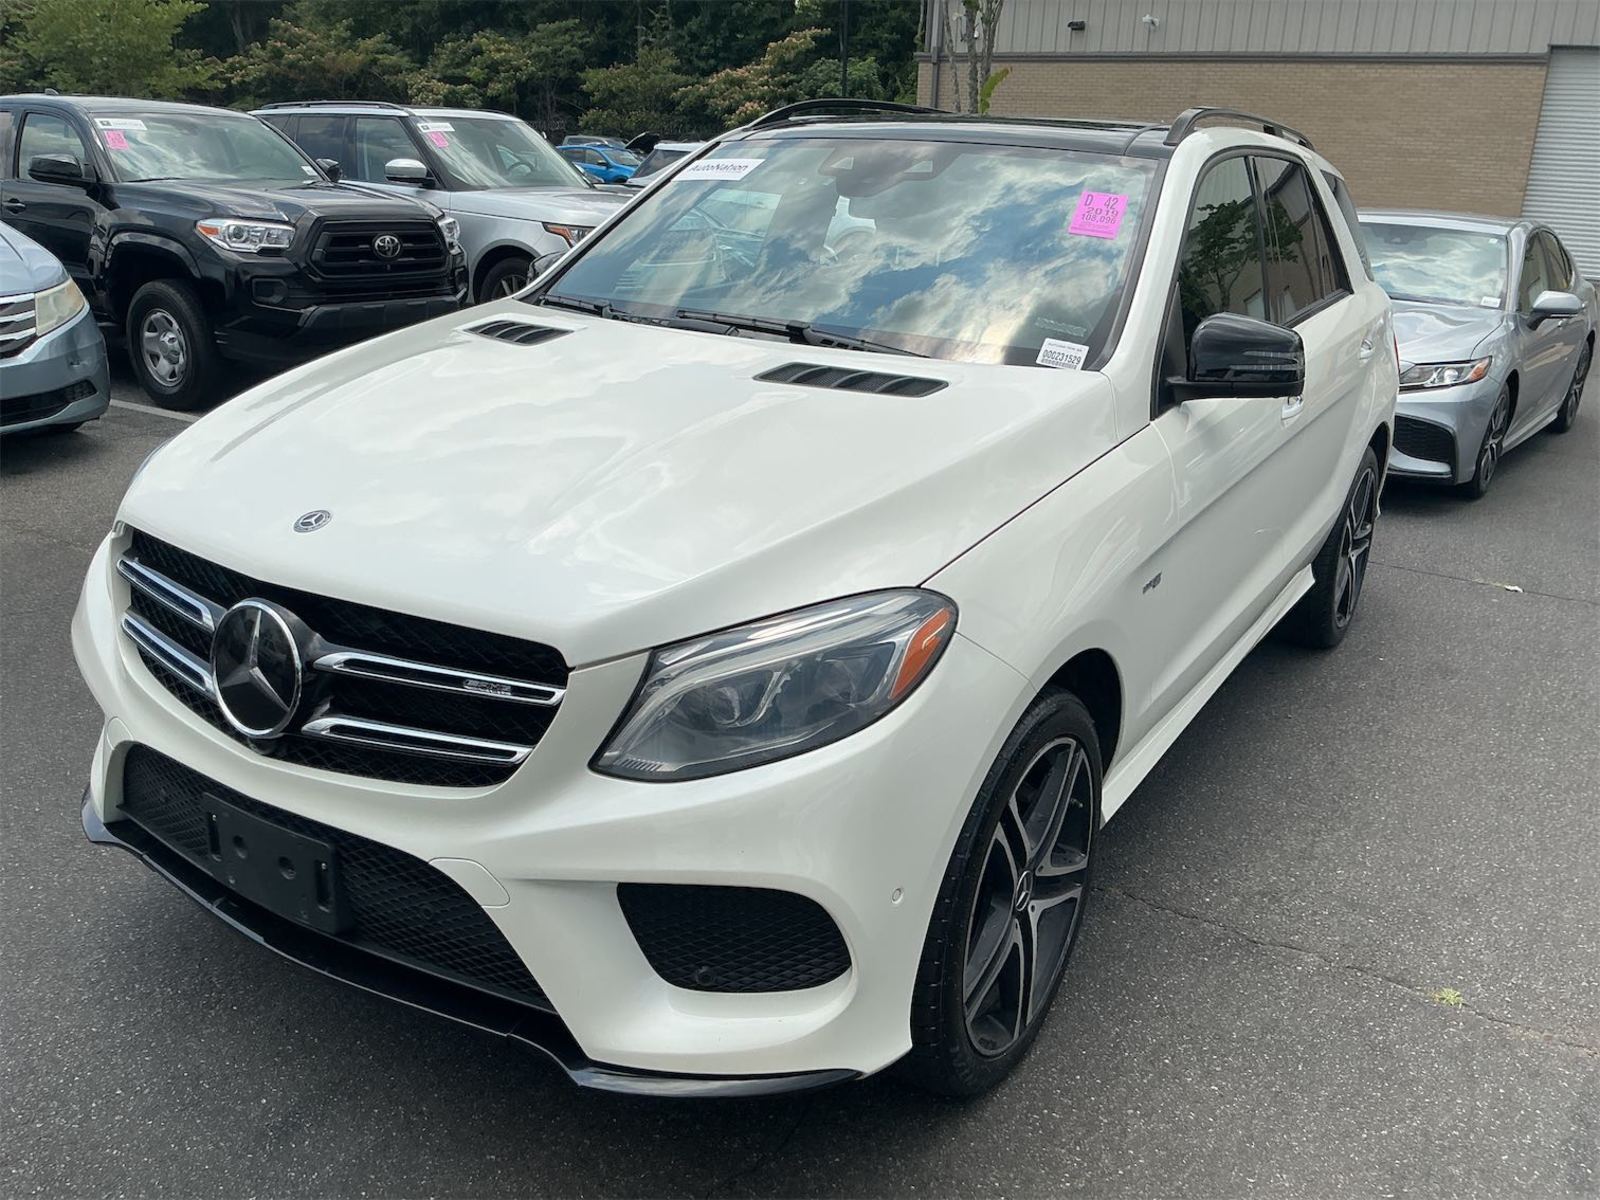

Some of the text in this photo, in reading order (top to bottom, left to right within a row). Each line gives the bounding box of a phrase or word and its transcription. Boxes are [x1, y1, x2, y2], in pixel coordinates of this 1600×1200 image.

[1084, 193, 1119, 210] D 42
[1085, 206, 1119, 219] 2019
[1042, 349, 1082, 365] 000231529
